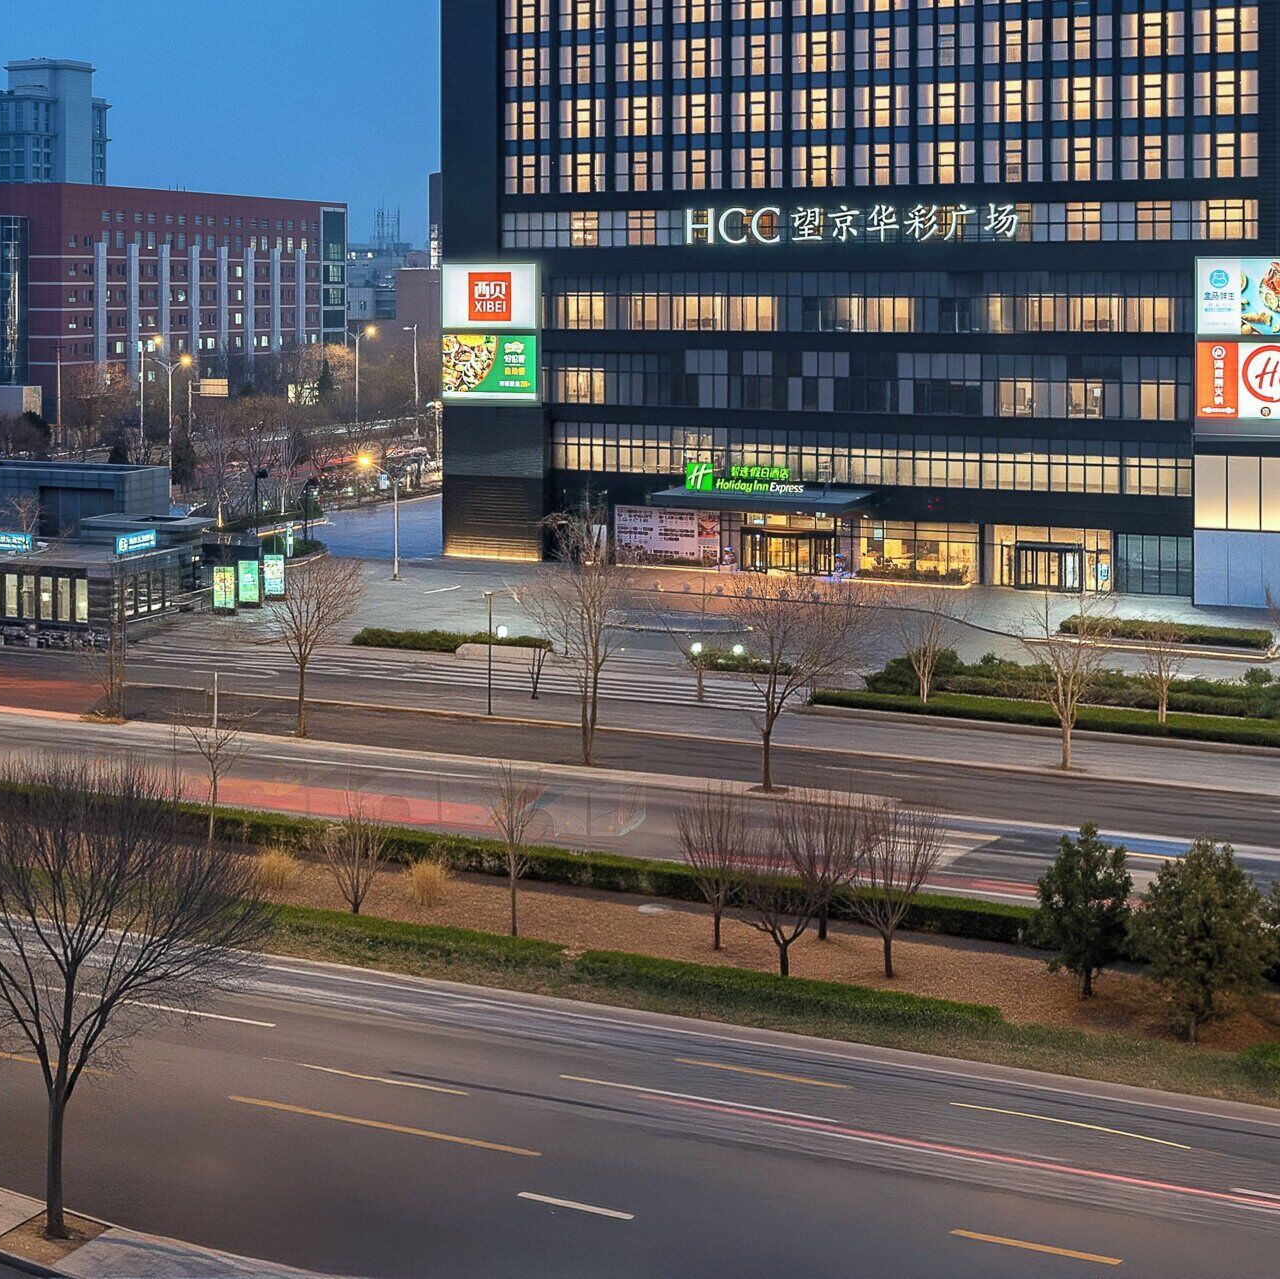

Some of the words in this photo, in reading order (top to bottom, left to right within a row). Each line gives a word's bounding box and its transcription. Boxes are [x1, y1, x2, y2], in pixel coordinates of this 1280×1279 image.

[684, 206, 781, 245] HCC
[790, 202, 1020, 244] 望京华彩广场
[474, 300, 507, 313] XIBEI
[715, 478, 753, 493] Holiday
[753, 479, 769, 492] Inn
[769, 481, 805, 494] Express
